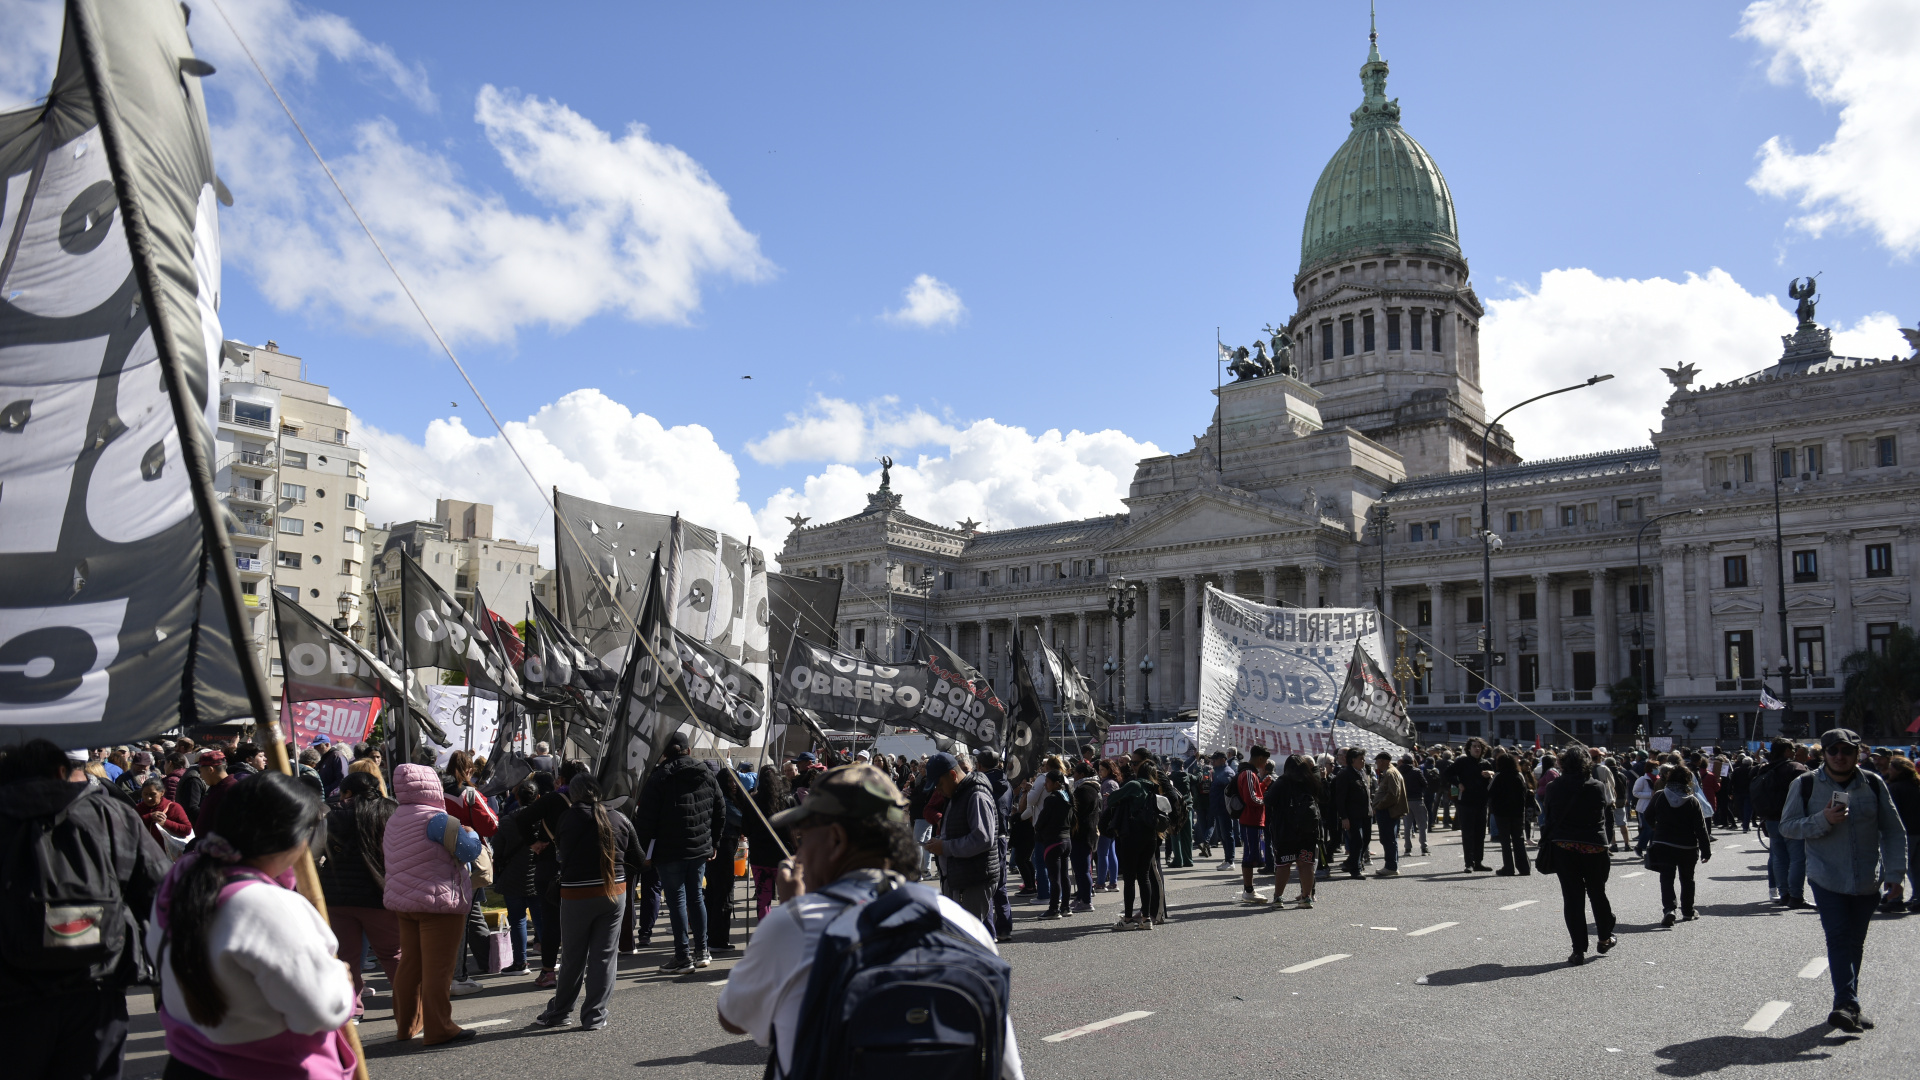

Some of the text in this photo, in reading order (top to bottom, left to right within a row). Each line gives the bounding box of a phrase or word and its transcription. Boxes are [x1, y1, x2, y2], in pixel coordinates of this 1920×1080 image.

[790, 665, 921, 708] OBRERO
[932, 678, 985, 718] POLO
[1360, 681, 1406, 717] POLO
[924, 695, 996, 742] BRERO
[1346, 695, 1410, 737] OBRERO
[1299, 849, 1313, 862] 23
